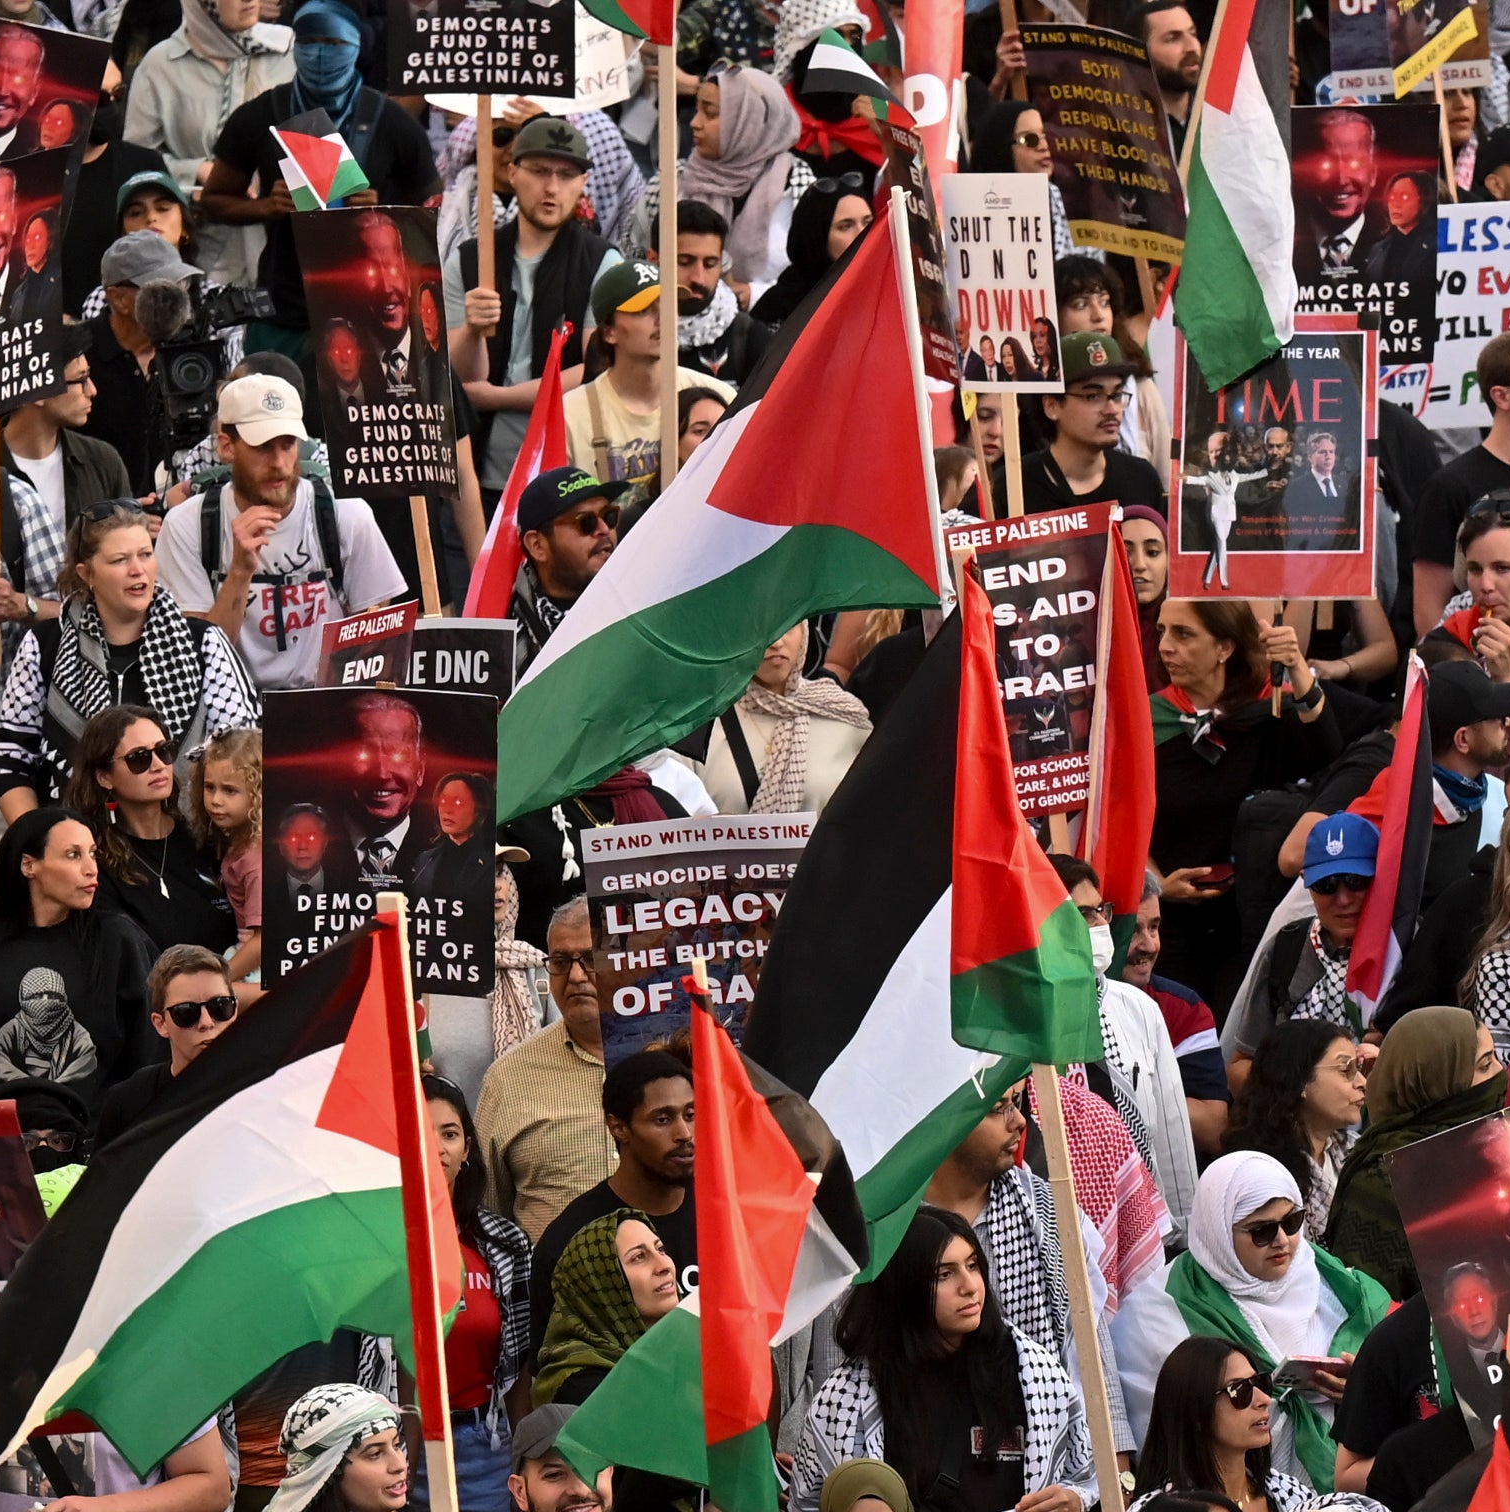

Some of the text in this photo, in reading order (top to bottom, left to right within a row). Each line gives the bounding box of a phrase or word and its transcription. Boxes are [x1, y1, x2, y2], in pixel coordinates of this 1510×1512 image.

[950, 216, 1042, 243] SHUT THE
[1281, 348, 1340, 359] THE YEAR
[348, 404, 445, 422] DEMOCRATS
[363, 424, 442, 441] FUND THE
[346, 446, 452, 464] GENOCIDE OF
[344, 466, 456, 485] PALESTINIANS
[338, 610, 405, 642] FREE PALESTINE
[342, 655, 385, 684] END
[435, 650, 489, 683] DNC
[590, 824, 810, 855] STAND WITH PALESTINE
[602, 865, 725, 891] GENOCIDE
